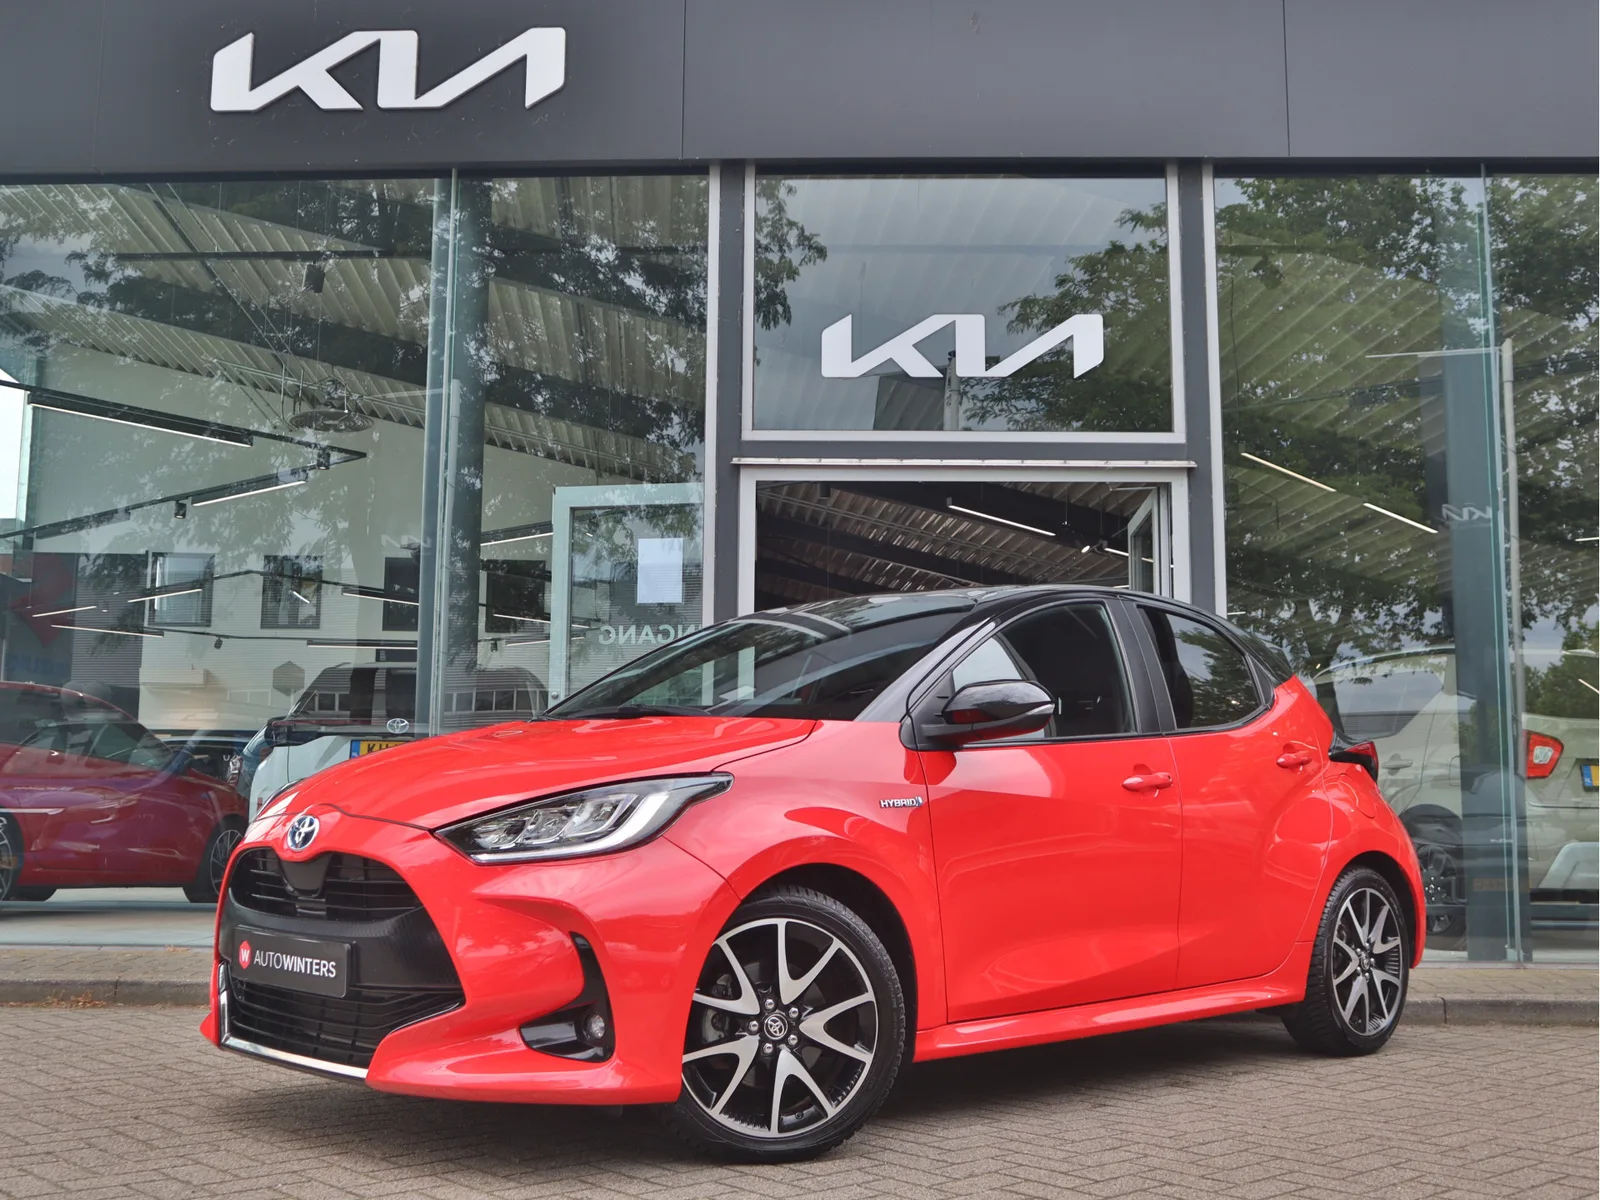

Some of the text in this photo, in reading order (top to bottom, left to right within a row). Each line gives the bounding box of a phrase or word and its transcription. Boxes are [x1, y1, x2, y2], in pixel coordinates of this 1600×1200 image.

[210, 26, 566, 112] KIA
[821, 313, 1104, 379] KIA
[880, 798, 917, 808] HYBRID
[253, 949, 337, 978] AUTOWINTERS
